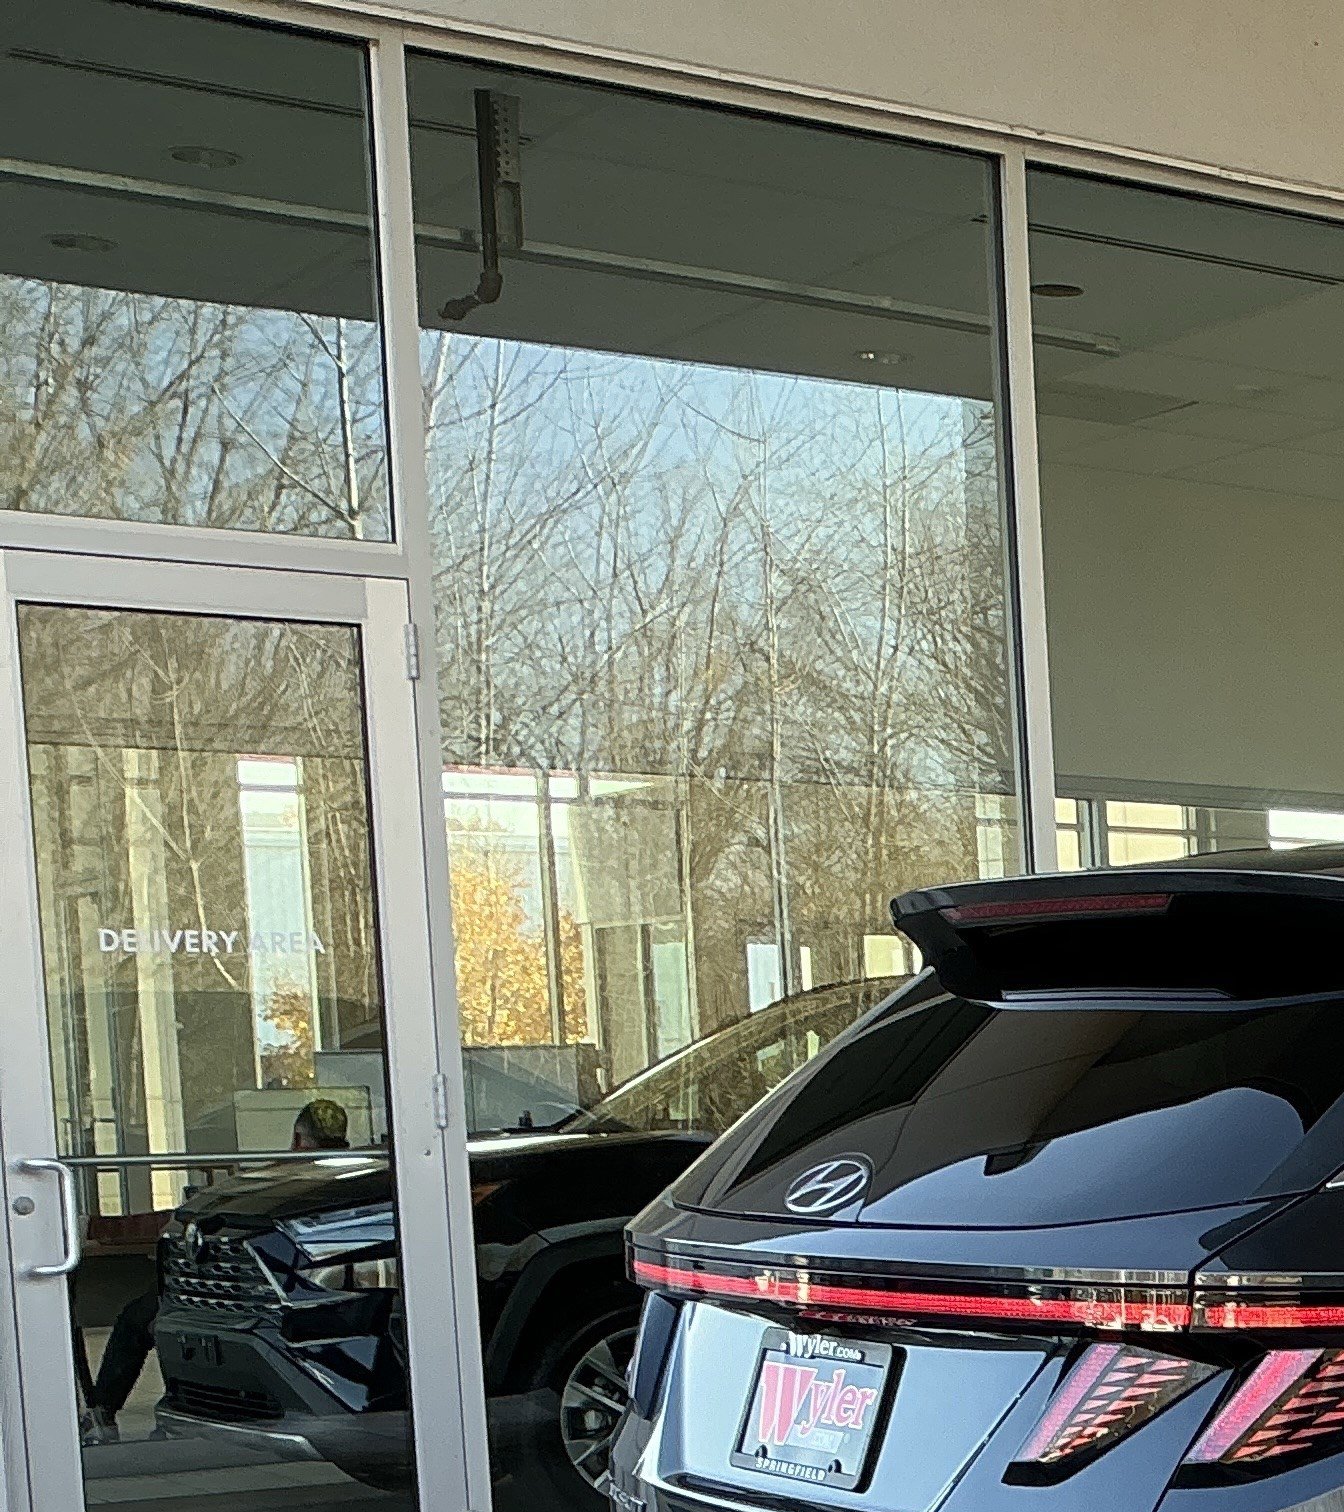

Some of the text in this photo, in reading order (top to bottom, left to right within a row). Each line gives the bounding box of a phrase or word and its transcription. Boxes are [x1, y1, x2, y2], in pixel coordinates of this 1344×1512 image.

[248, 931, 326, 954] AREA
[758, 1361, 878, 1446] Wyler
[755, 1457, 826, 1481] SPRINGFIELD
